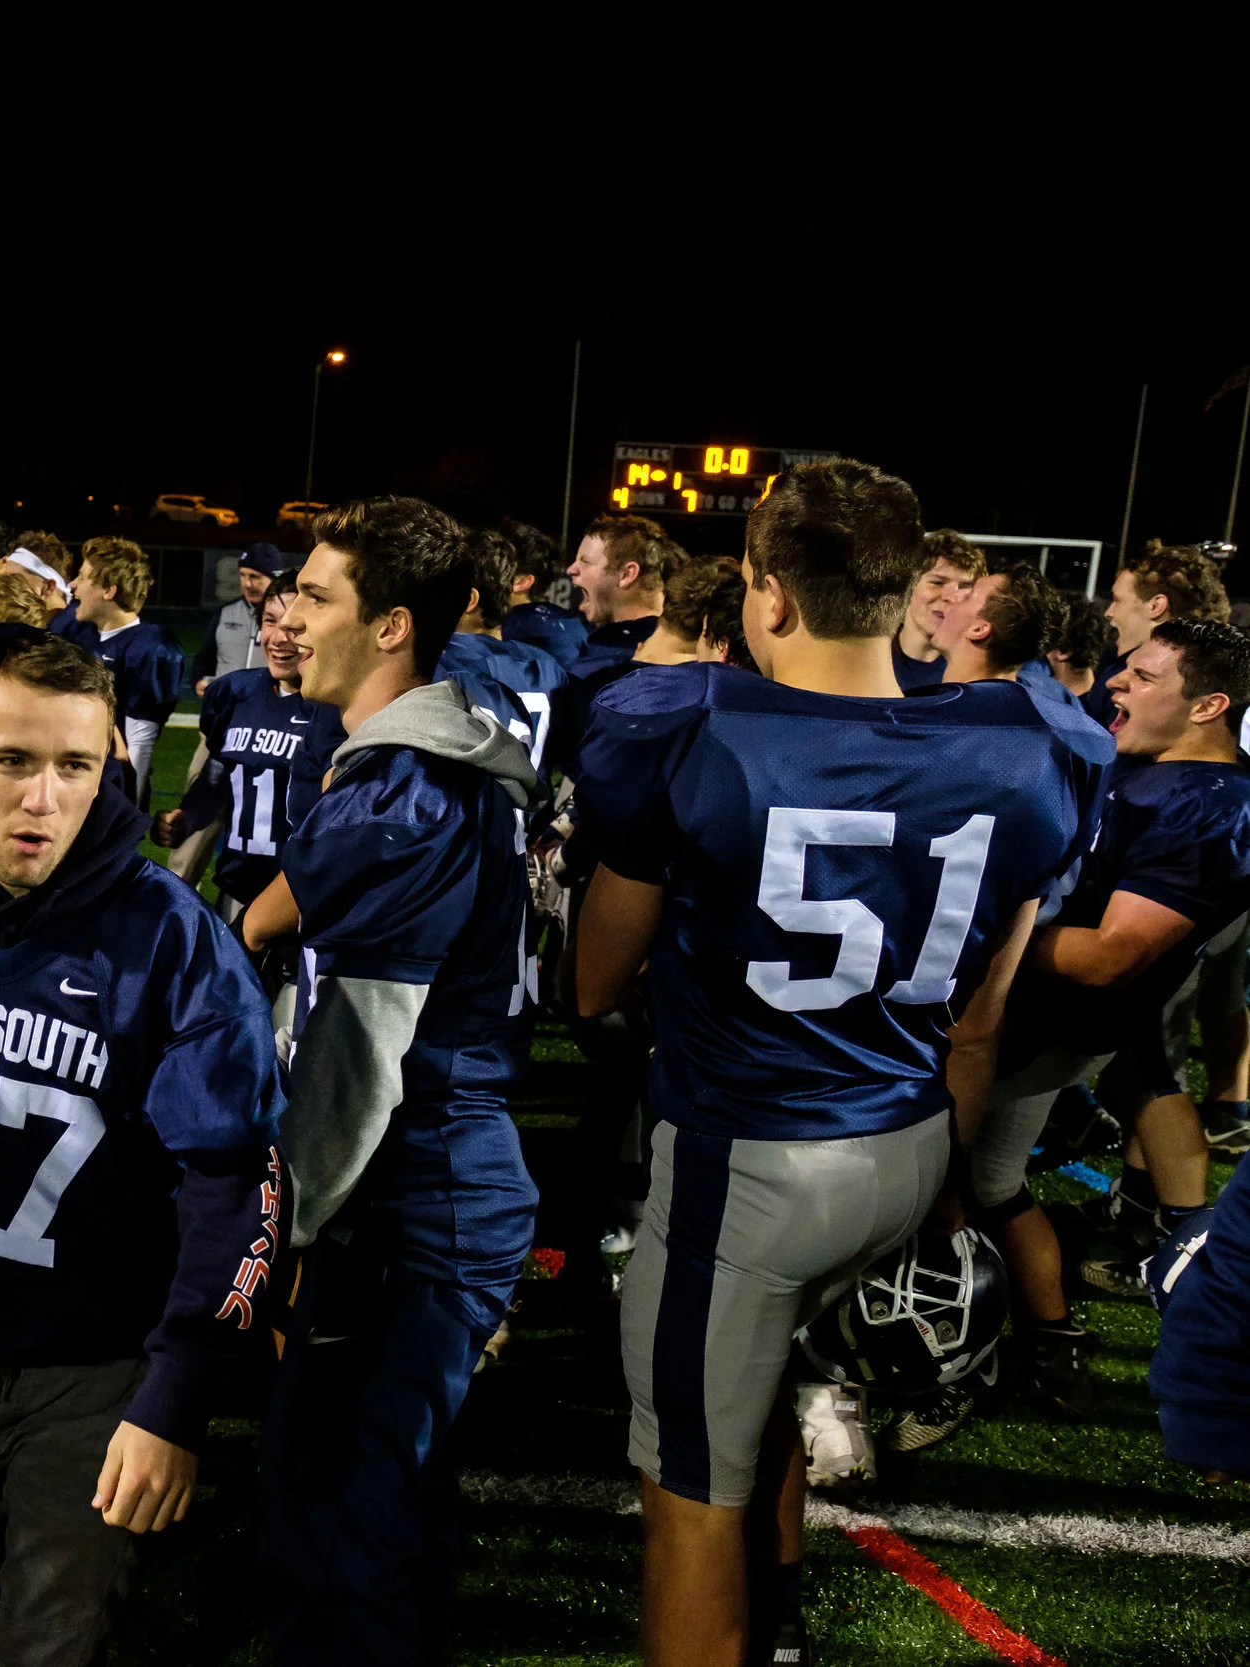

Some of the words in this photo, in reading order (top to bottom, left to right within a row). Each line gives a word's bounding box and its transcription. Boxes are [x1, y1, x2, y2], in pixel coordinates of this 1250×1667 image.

[704, 447, 749, 475] 0.0
[613, 487, 629, 509] 4
[682, 489, 698, 513] 7
[252, 728, 303, 760] SOUT
[227, 763, 277, 857] 11
[746, 807, 996, 1012] 51
[773, 1648, 802, 1663] NIKE
